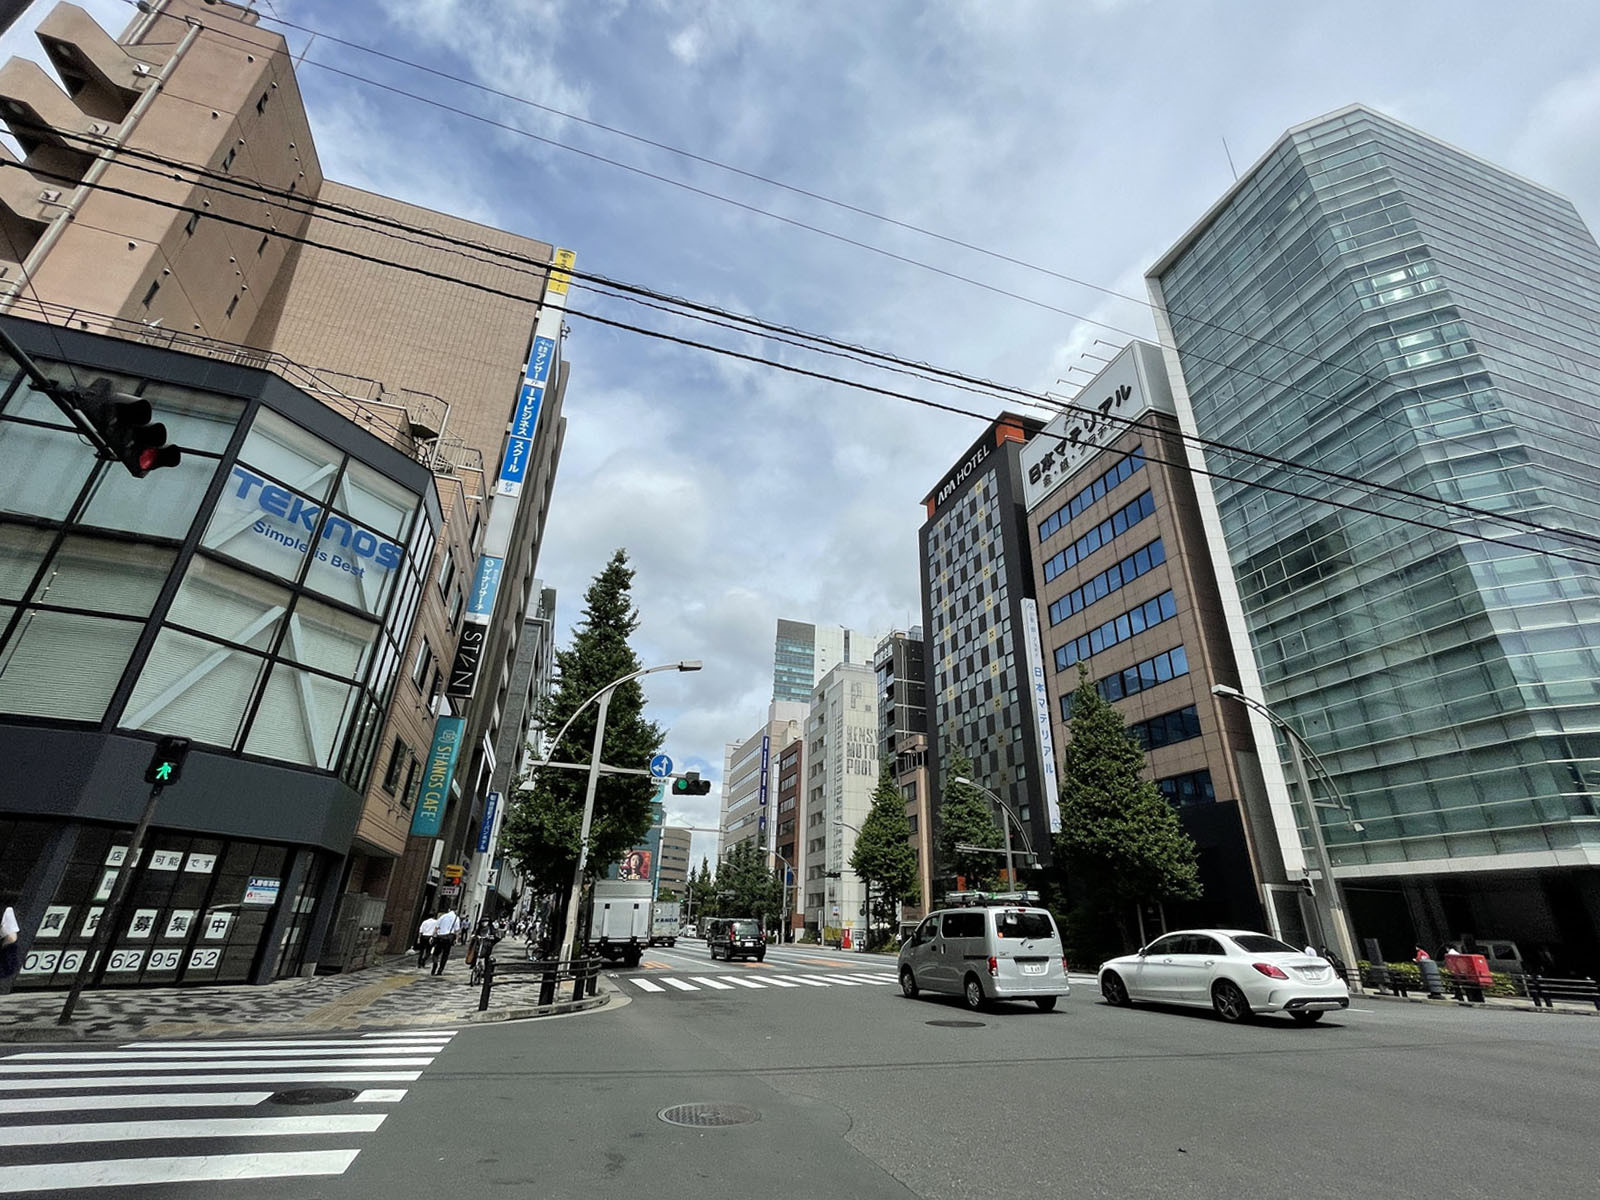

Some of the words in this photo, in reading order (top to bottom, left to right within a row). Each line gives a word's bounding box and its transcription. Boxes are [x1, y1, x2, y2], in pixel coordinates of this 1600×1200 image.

[508, 440, 524, 473] スクール
[1029, 385, 1132, 485] 日本マテリアル
[937, 479, 956, 505] APA
[956, 444, 991, 486] HOTEL
[253, 520, 308, 553] Simple
[315, 548, 327, 562] is
[330, 554, 366, 579] Best
[1034, 667, 1054, 774] 日本マテリアル
[428, 746, 452, 788] SHANGS
